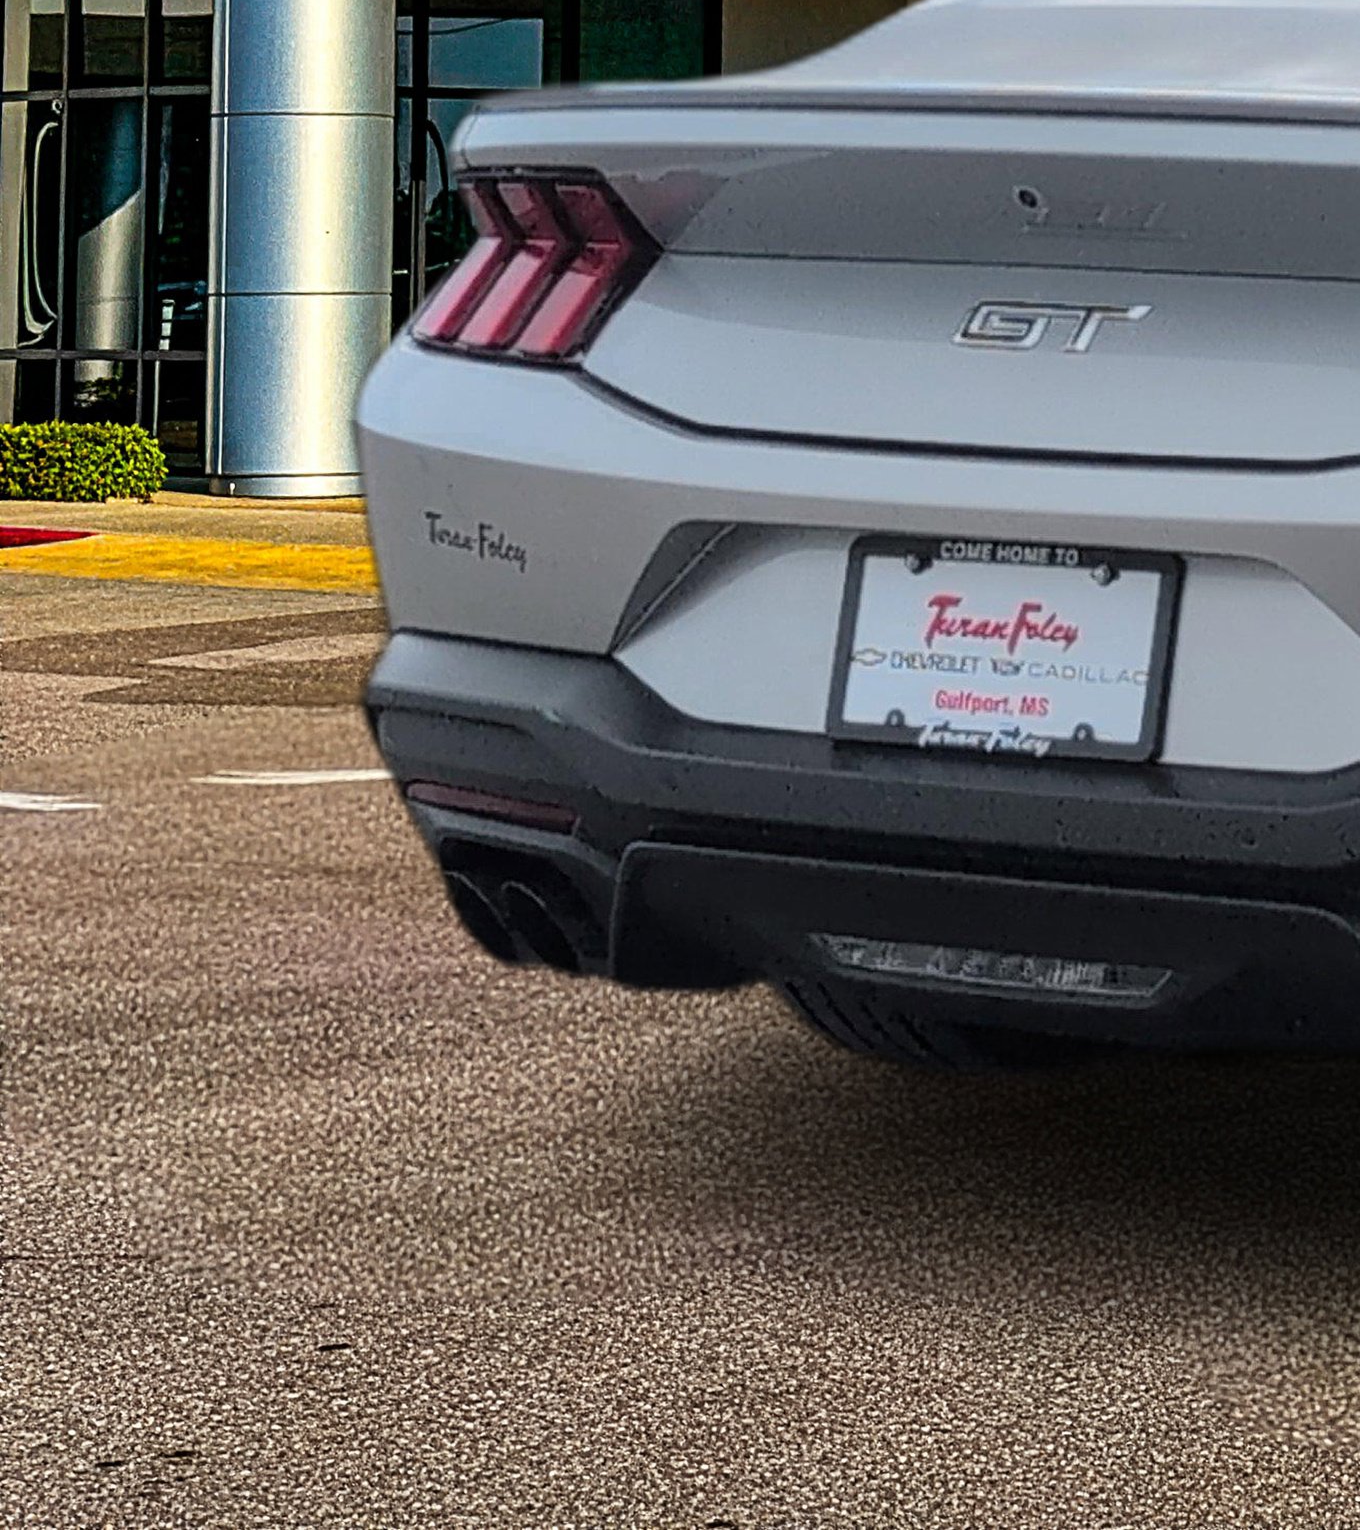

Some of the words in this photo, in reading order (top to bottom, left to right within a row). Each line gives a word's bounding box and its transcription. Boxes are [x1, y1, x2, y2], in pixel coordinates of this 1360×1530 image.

[953, 298, 1152, 352] GT
[940, 540, 992, 559] COME
[997, 543, 1049, 565] HOME
[1055, 548, 1080, 566] TO
[890, 650, 982, 675] CHEVROLET
[1027, 662, 1150, 685] CADILLAC
[934, 688, 1014, 716] Gulfport,
[1019, 695, 1050, 717] MS
